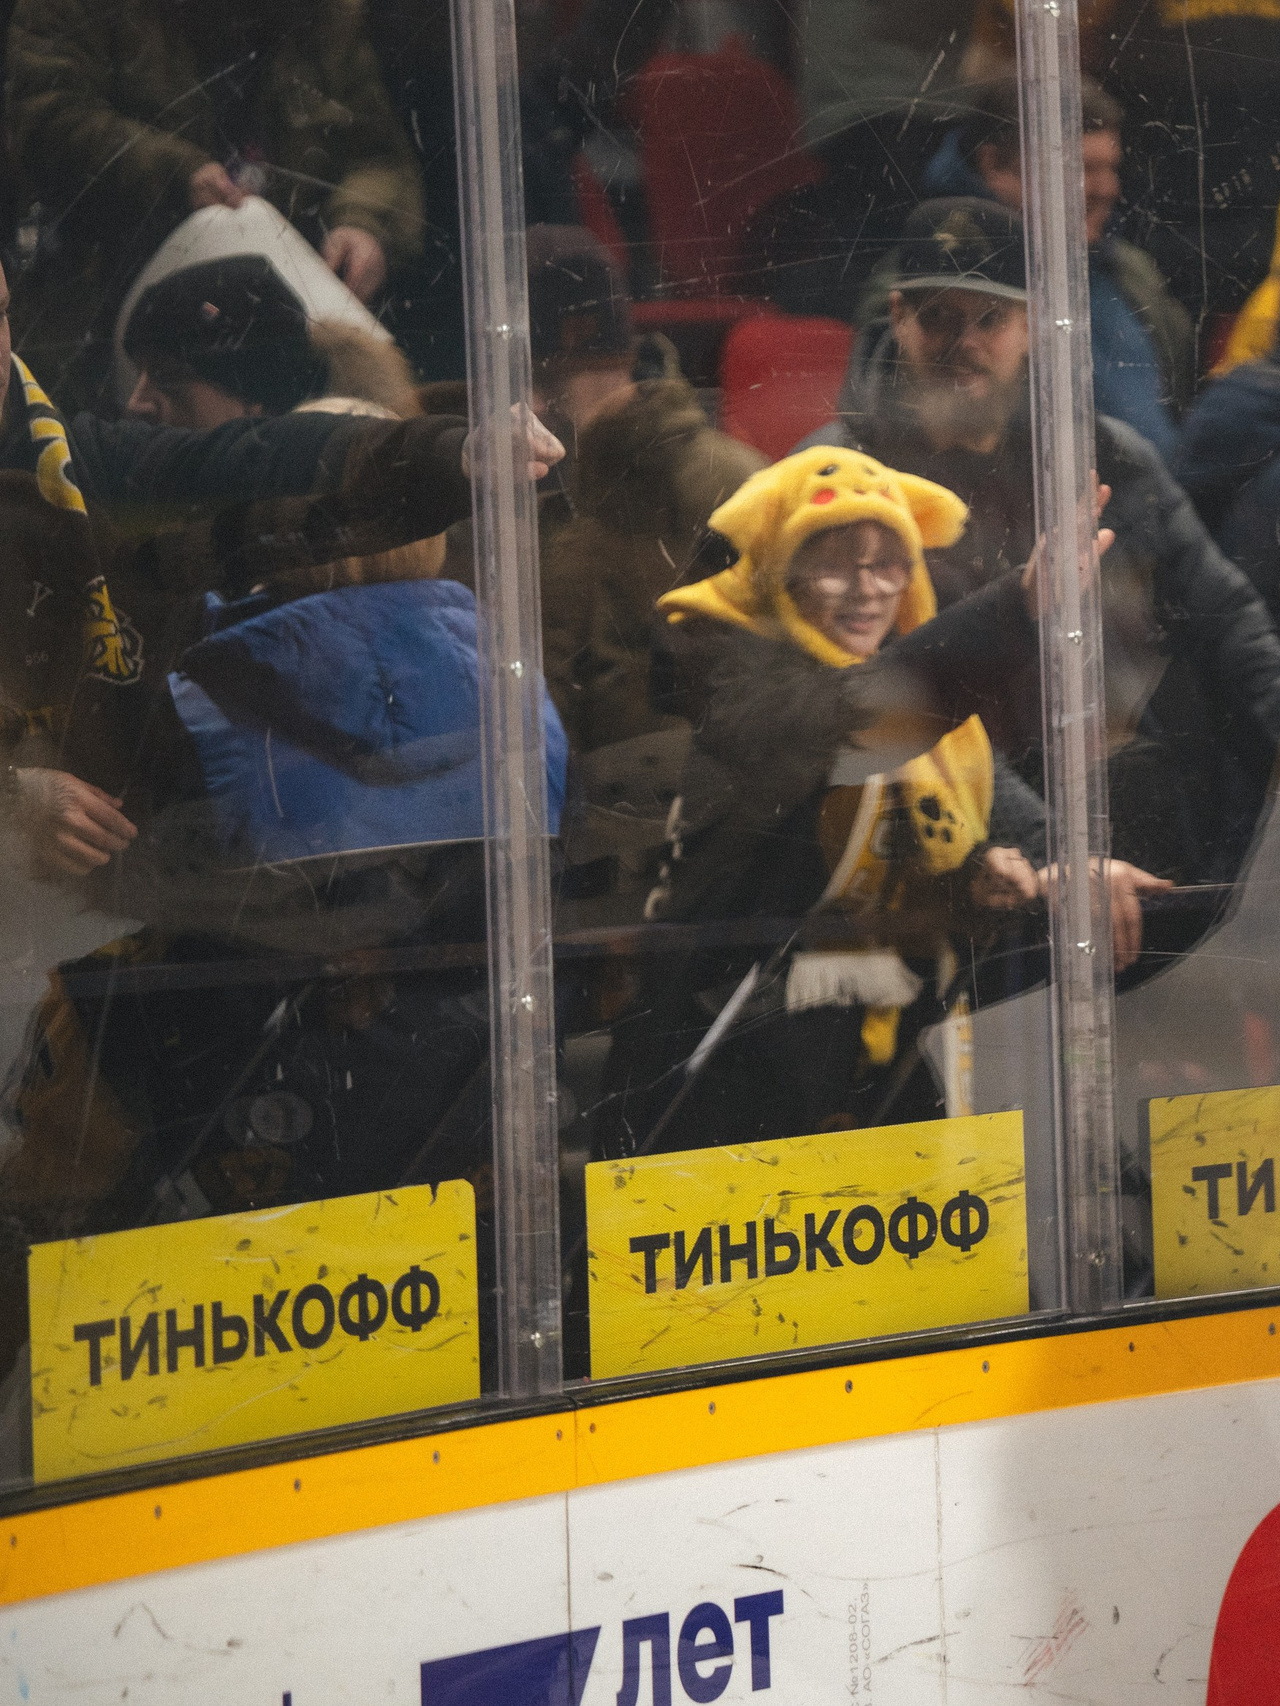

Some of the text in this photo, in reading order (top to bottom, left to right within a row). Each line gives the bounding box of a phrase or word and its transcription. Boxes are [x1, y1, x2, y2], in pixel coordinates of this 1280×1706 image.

[629, 1189, 990, 1295] ТИНЬКОФФ
[73, 1264, 441, 1386] ТИНЬКОФФ
[616, 1589, 784, 1706] лет
